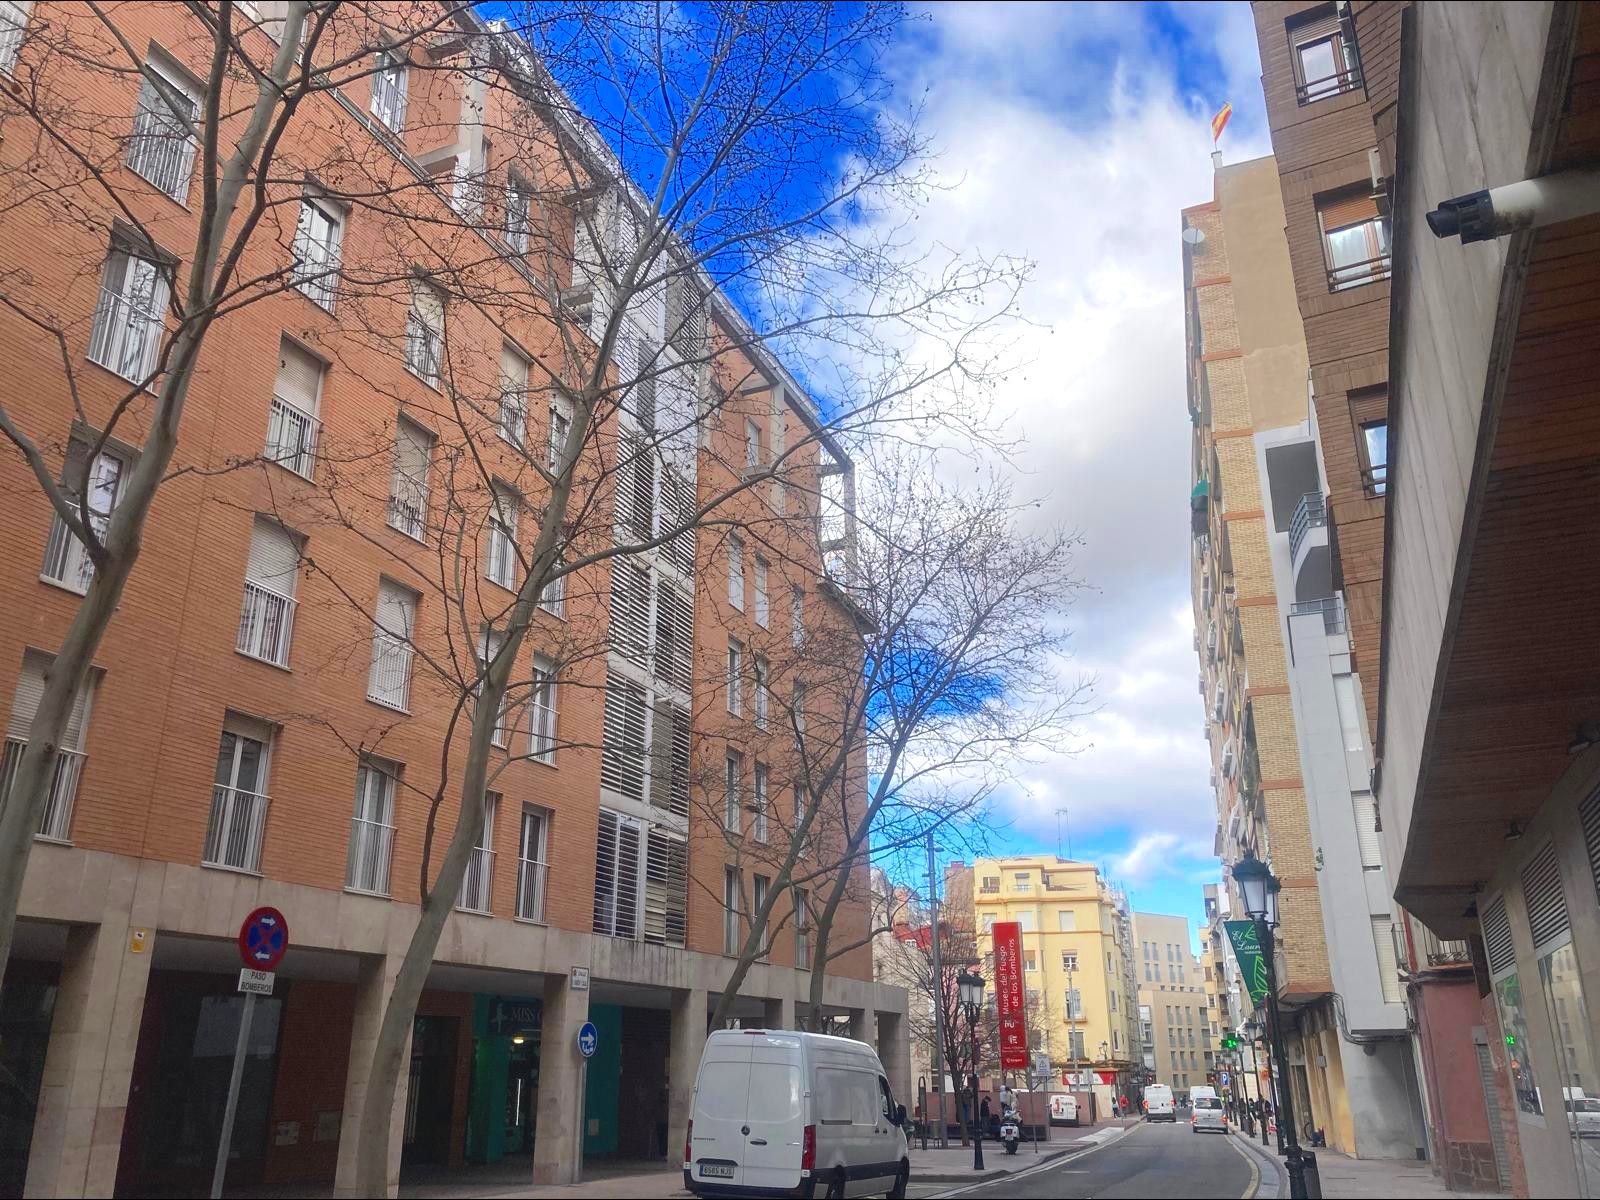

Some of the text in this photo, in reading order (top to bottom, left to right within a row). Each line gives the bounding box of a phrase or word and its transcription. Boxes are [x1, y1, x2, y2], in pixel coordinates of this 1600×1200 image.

[1009, 938, 1017, 979] Bomberos
[251, 971, 266, 980] PASO
[241, 982, 272, 992] BOMBEROS
[1012, 996, 1019, 1007] de
